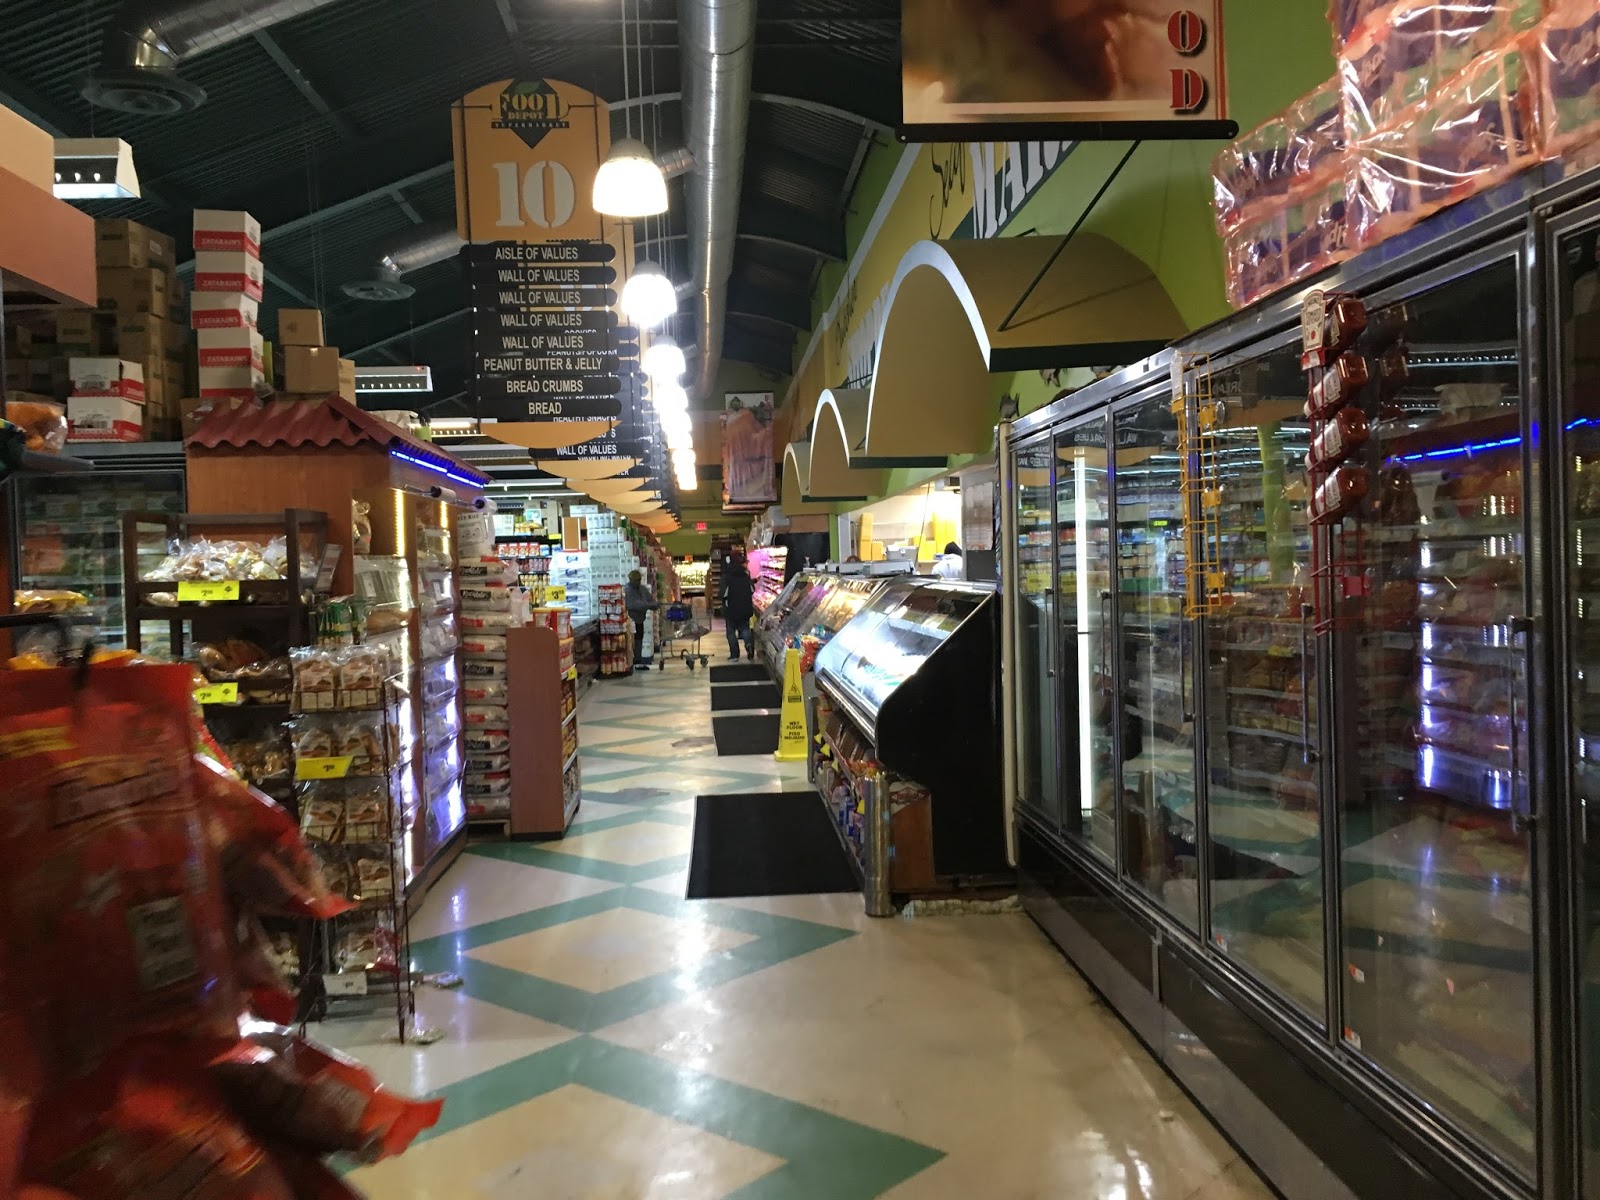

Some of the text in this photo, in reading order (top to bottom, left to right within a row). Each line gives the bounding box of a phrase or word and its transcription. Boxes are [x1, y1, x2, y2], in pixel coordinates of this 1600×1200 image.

[492, 94, 569, 120] FOOD
[493, 161, 575, 228] 10
[495, 247, 578, 260] AISLE OF VALUES
[498, 269, 580, 282] WALL OF VALUES
[499, 291, 581, 304] WALL OF VALUES
[501, 314, 582, 327] WALL OF VALUES
[502, 336, 584, 349] WALL OF VALUES
[484, 358, 602, 371] PEANUT BUTTER & JELLY
[506, 380, 584, 393] BREAD CRUMBS
[528, 402, 562, 415] BREAD
[556, 445, 617, 456] WALL OF VALUES
